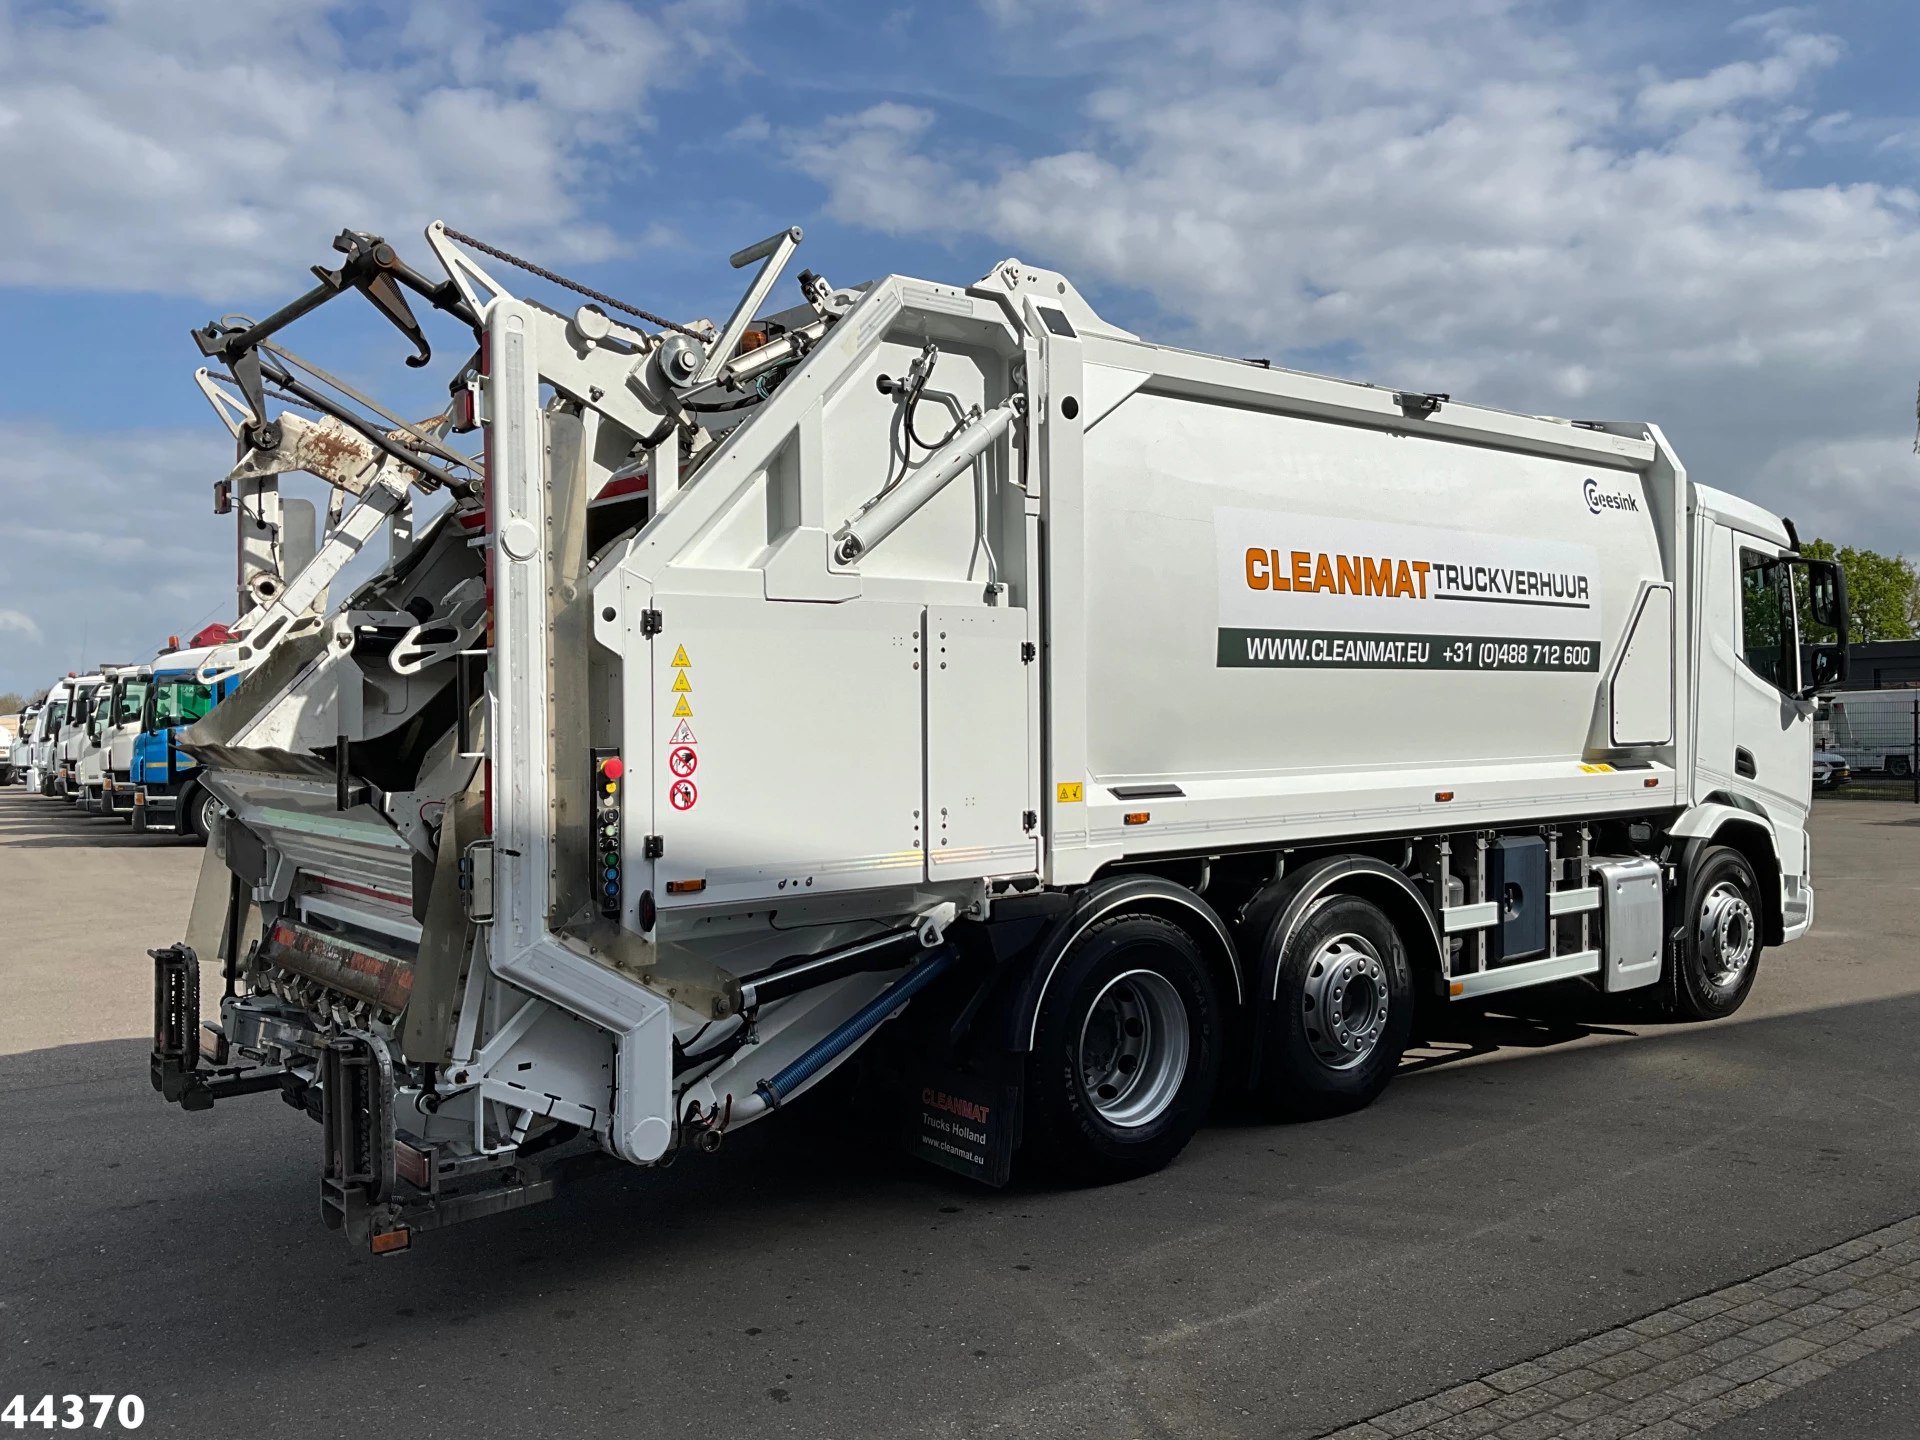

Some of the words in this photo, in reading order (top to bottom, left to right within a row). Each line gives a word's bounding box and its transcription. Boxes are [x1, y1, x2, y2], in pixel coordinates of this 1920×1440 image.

[1587, 486, 1639, 512] Geesink
[1245, 547, 1430, 599] CLEANMAT
[1432, 563, 1589, 600] TRUCKVERHUUR
[1246, 637, 1430, 663] WWW.CLEANMAT.EU
[1443, 642, 1473, 663] +31
[1479, 643, 1528, 667] (0)488
[1533, 645, 1560, 665] 712
[1564, 646, 1591, 666] 600
[921, 1087, 990, 1124] CLEANMAT
[922, 1112, 950, 1132] Trucks
[952, 1122, 987, 1145] Holland
[922, 1134, 984, 1165] www.cleanmat.eu
